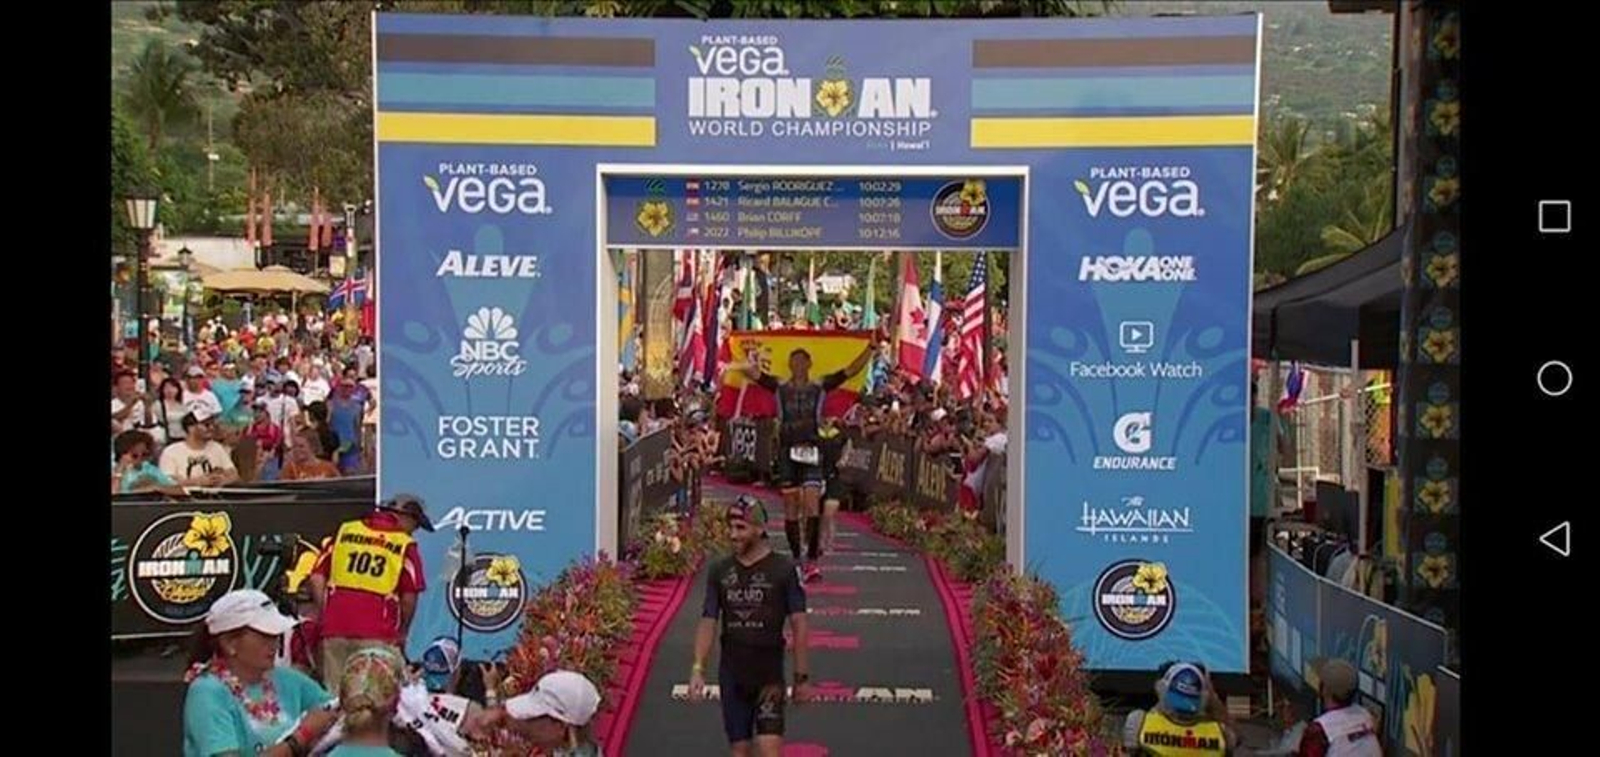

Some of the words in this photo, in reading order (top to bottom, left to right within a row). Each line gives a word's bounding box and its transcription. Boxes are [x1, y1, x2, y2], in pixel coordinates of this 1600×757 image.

[702, 35, 778, 45] PLANT-BASED
[688, 77, 931, 118] IRONAN
[690, 121, 763, 136] WORLD
[772, 121, 932, 136] CHAMPIONSHIP
[439, 163, 537, 175] PLANT-BASED
[1090, 167, 1190, 178] PLANT-BASED
[436, 250, 537, 277] ALEVE
[1079, 256, 1161, 281] HOKA
[1160, 256, 1193, 268] ONE
[1161, 269, 1195, 281] ONE
[461, 341, 520, 361] NBC
[450, 355, 527, 379] Sports
[1070, 361, 1145, 377] Facebook
[1151, 361, 1202, 378] Watch
[438, 416, 539, 436] FOSTER
[437, 438, 538, 458] GRANT
[1093, 456, 1177, 470] ENDURANCE
[435, 506, 546, 530] ACTIVE
[1079, 500, 1190, 536] HAWAIIAN
[341, 533, 403, 555] IRONMAN
[137, 551, 230, 577] IRONMAN
[346, 550, 388, 578] 103
[1144, 729, 1220, 751] IRONMAN
